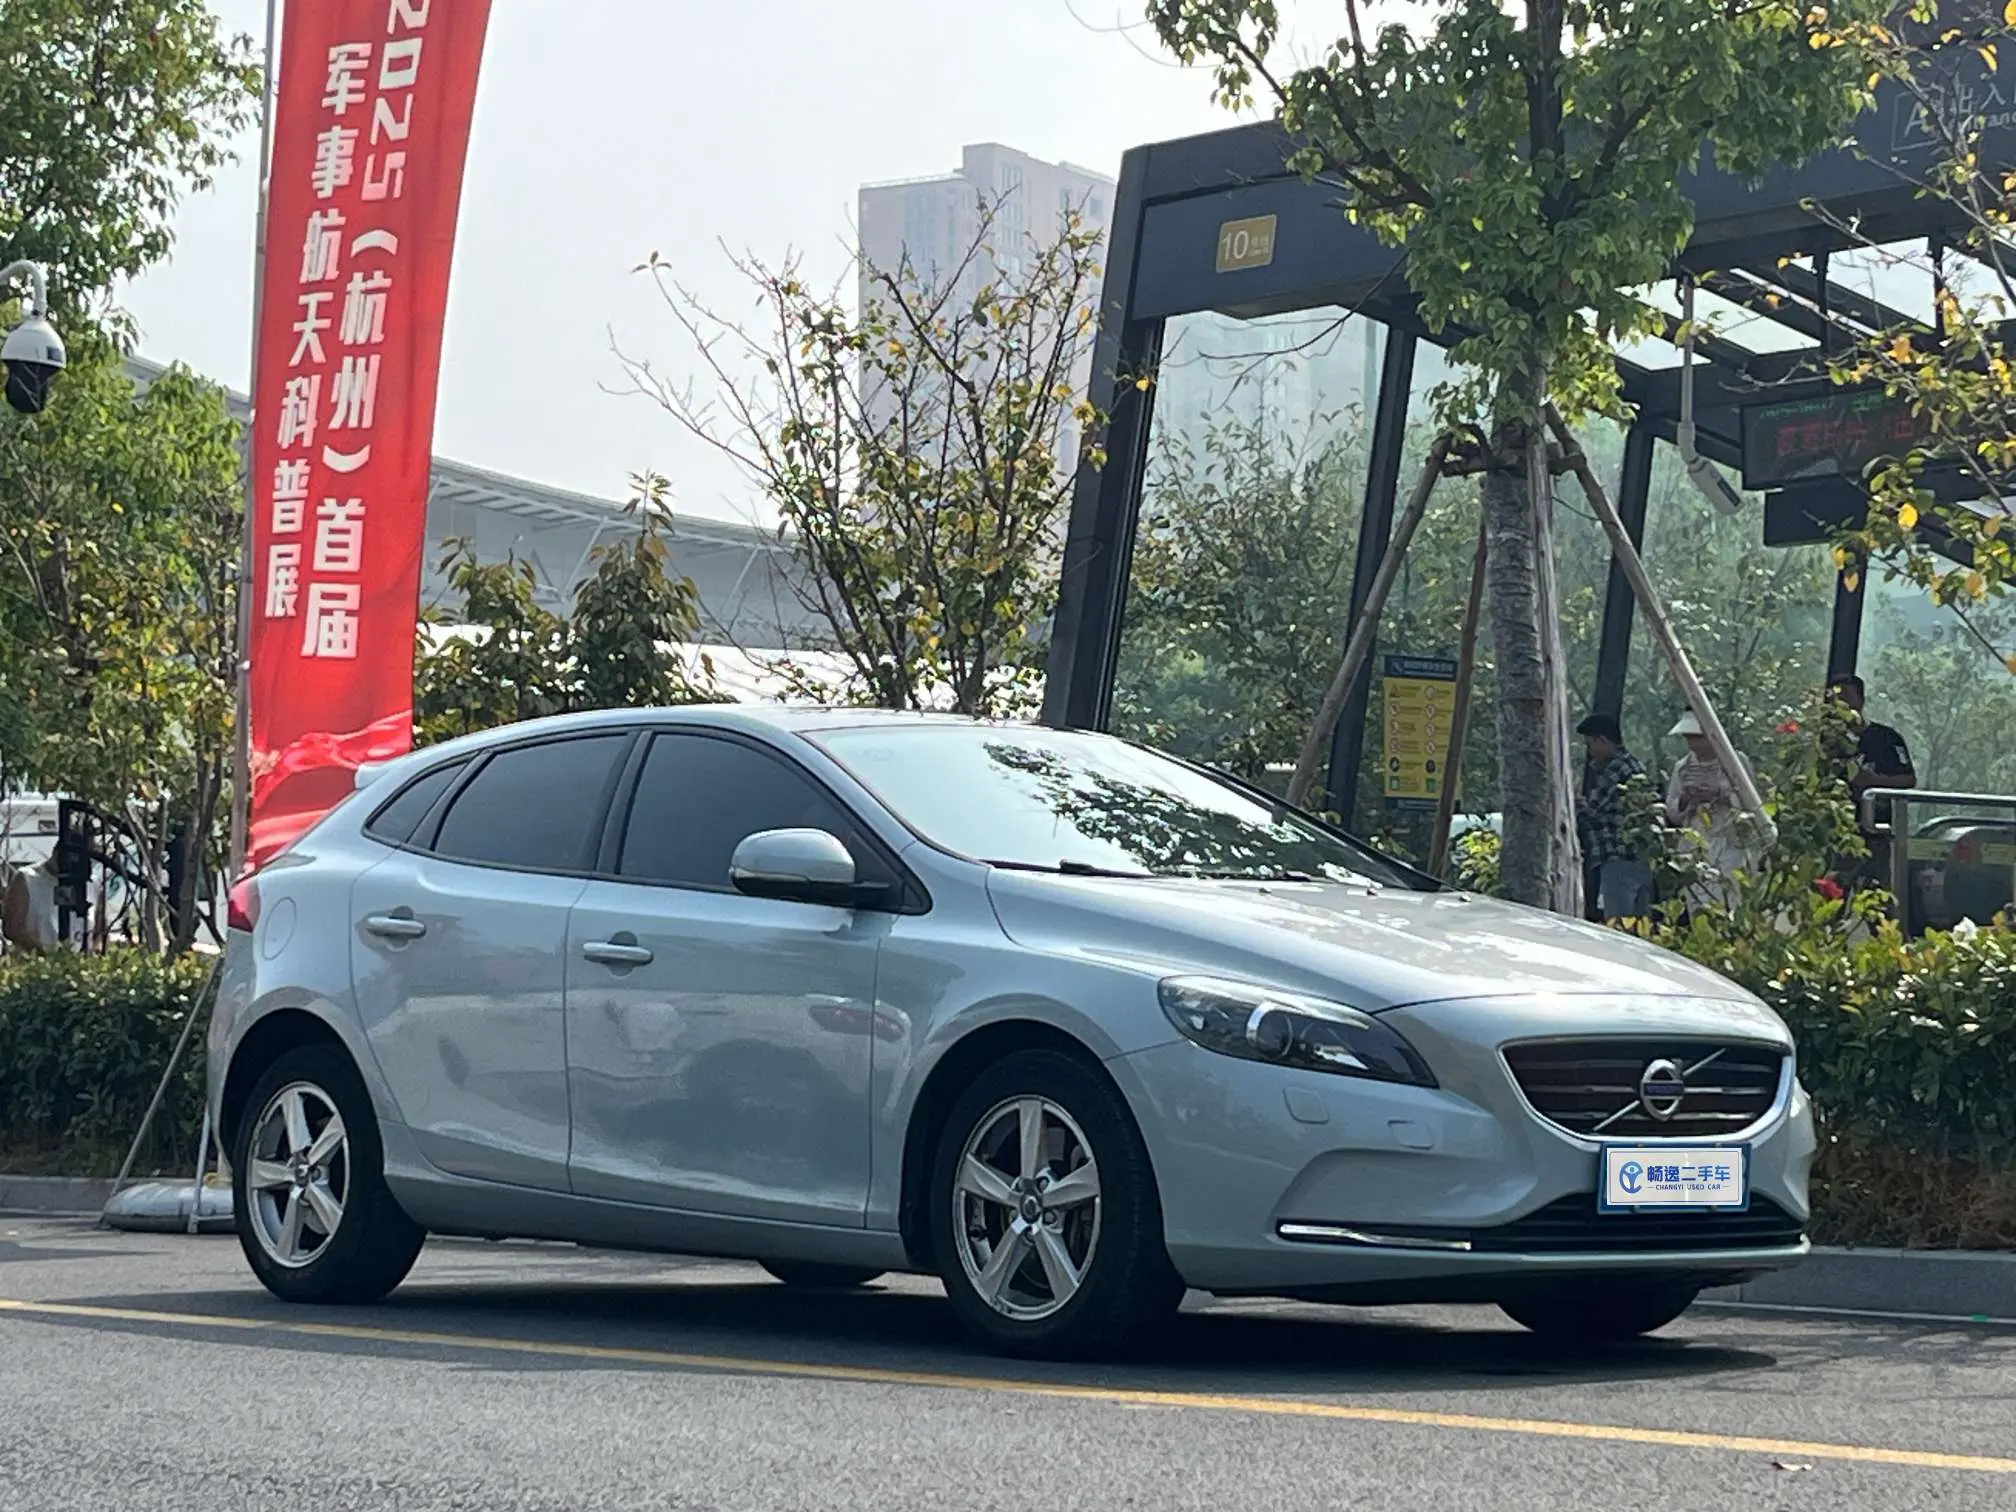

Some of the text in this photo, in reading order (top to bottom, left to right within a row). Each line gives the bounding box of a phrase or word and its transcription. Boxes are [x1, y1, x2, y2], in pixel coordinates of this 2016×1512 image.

[1950, 82, 2016, 114] 出入
[1220, 230, 1249, 262] 10
[264, 42, 373, 618] 军事航天科普展
[1647, 1165, 1731, 1182] 畅逸二手车
